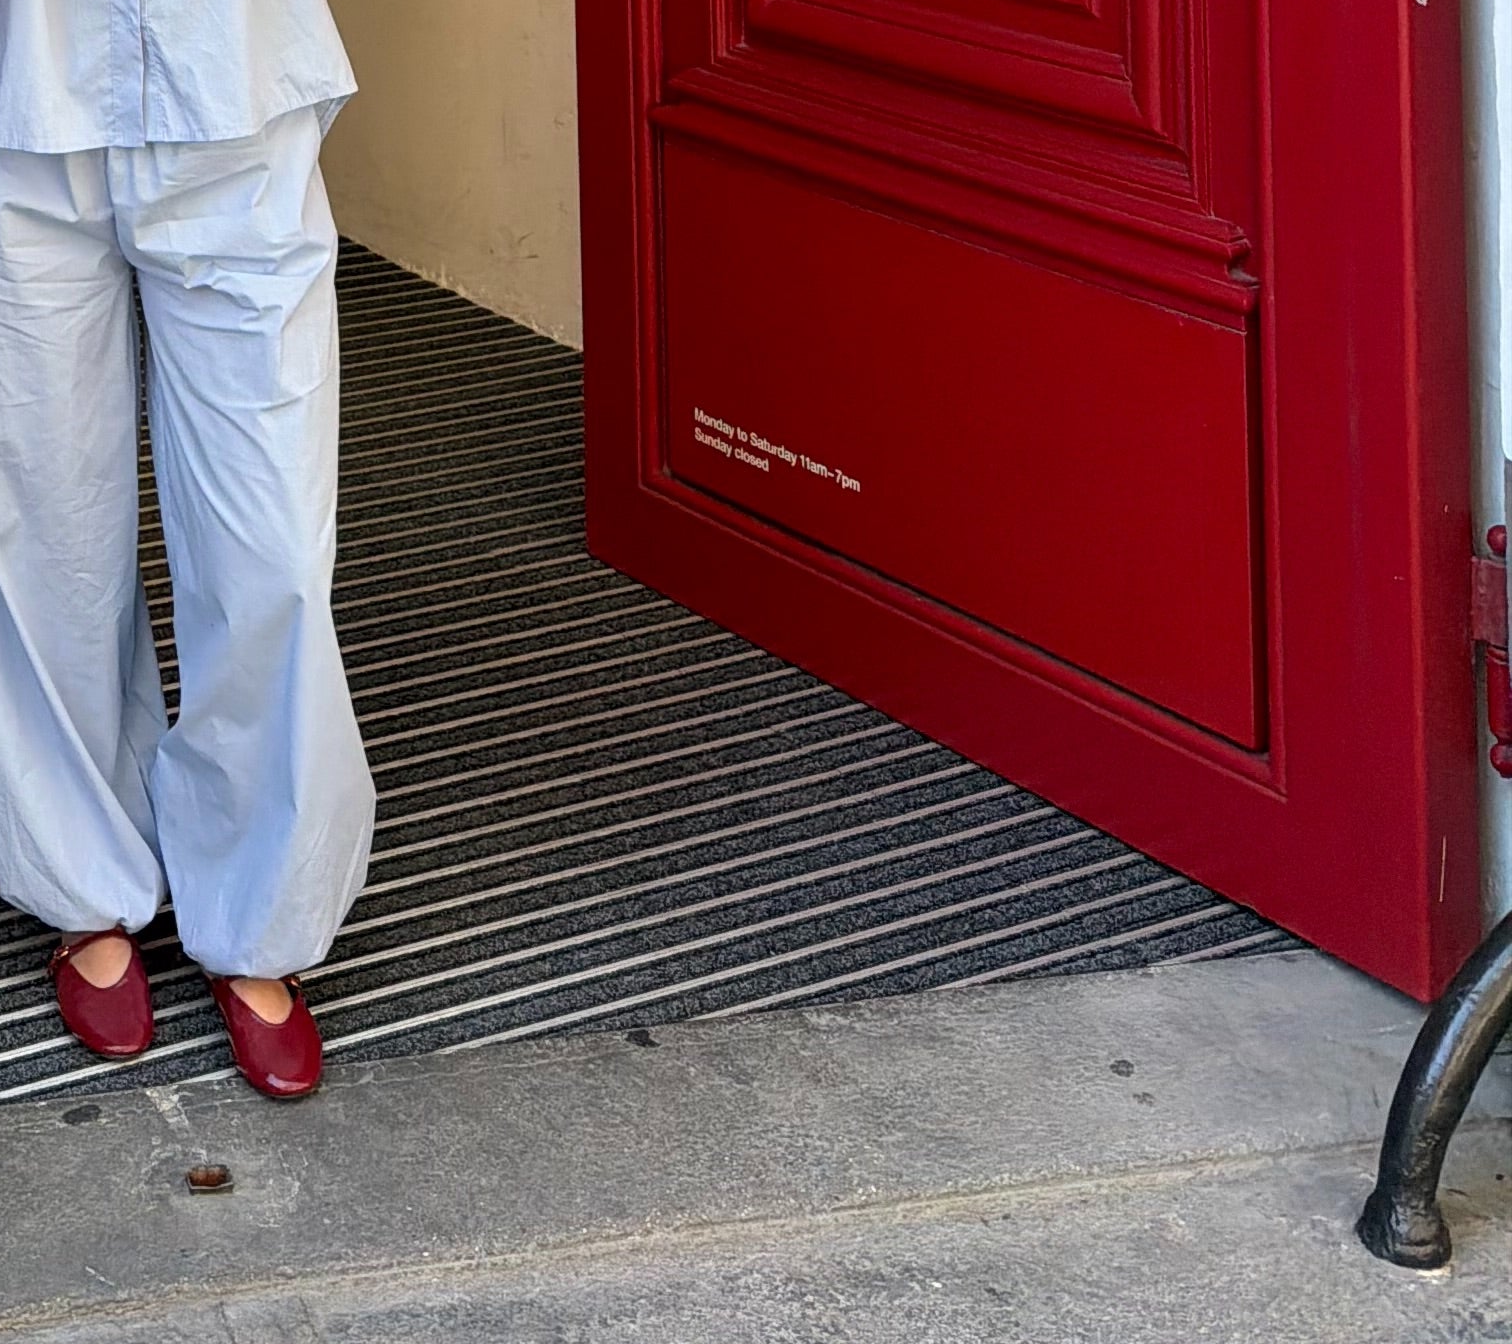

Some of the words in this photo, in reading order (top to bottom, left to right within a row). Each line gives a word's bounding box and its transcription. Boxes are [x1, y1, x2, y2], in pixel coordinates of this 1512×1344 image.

[694, 407, 734, 439] Monday
[737, 426, 748, 443] to
[749, 432, 798, 467] Saturday
[694, 427, 732, 458] Sunday
[734, 447, 770, 473] closed
